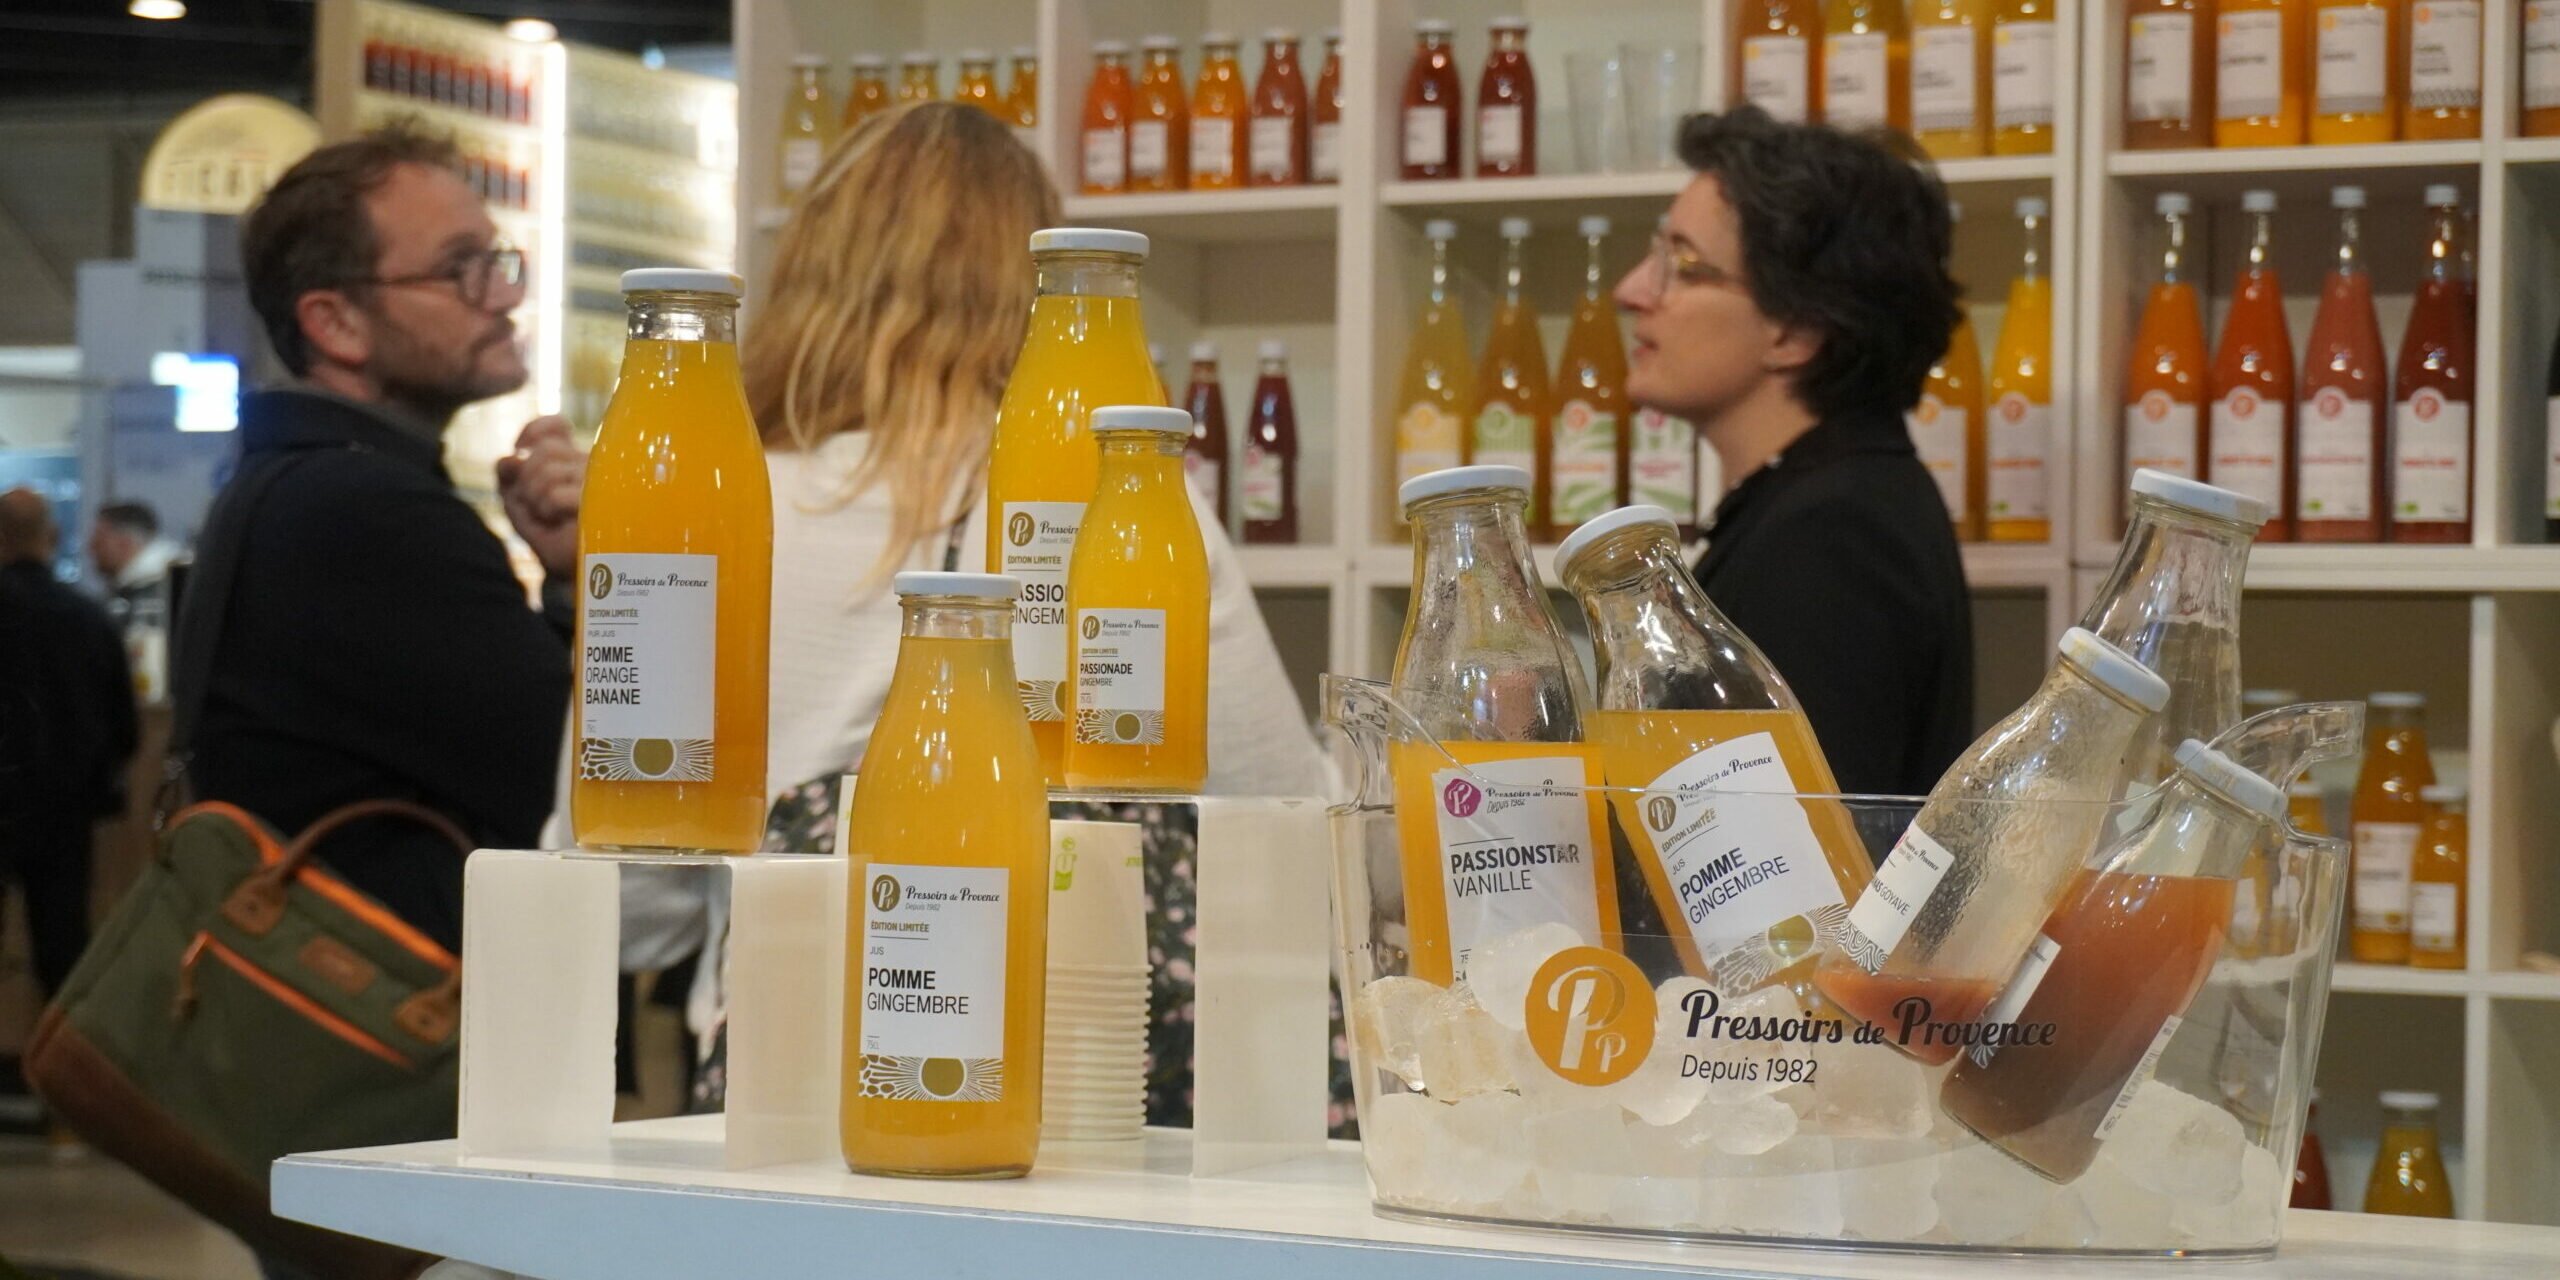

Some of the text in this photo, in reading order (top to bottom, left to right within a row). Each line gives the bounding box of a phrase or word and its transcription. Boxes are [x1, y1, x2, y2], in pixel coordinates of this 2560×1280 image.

[1034, 555, 1062, 564] LIMITÉE
[617, 572, 656, 586] Pressoirs
[667, 573, 708, 587] Provence
[611, 608, 639, 618] LIMITÉE
[586, 647, 633, 663] POMME
[586, 667, 639, 683] ORANGE
[1080, 663, 1133, 674] PASSIONADE
[1080, 677, 1112, 686] GINGEMBRE
[586, 688, 640, 705] BANANE
[1722, 769, 1730, 777] de
[1729, 756, 1773, 773] Provence
[1485, 787, 1531, 797] Pressoirs
[1661, 807, 1717, 852] ÉDITION LIMITÉE
[1451, 844, 1580, 874] PASSIONSTAR
[1671, 859, 1686, 875] JUS
[1453, 869, 1533, 898] VANILLE
[1680, 847, 1747, 904] POMME
[905, 885, 1000, 902] Pressoirs de Provence
[1689, 856, 1790, 924] GINGEMBRE
[1880, 886, 1910, 916] GOYAVE
[871, 920, 930, 932] ÉDITION LIMITÉE
[869, 946, 884, 955] JUS
[869, 967, 936, 989] POMME
[867, 992, 969, 1014] GINGEMBRE
[1681, 989, 2057, 1047] Pressoirs de Provence
[1681, 1054, 1817, 1085] Depuis 1982
